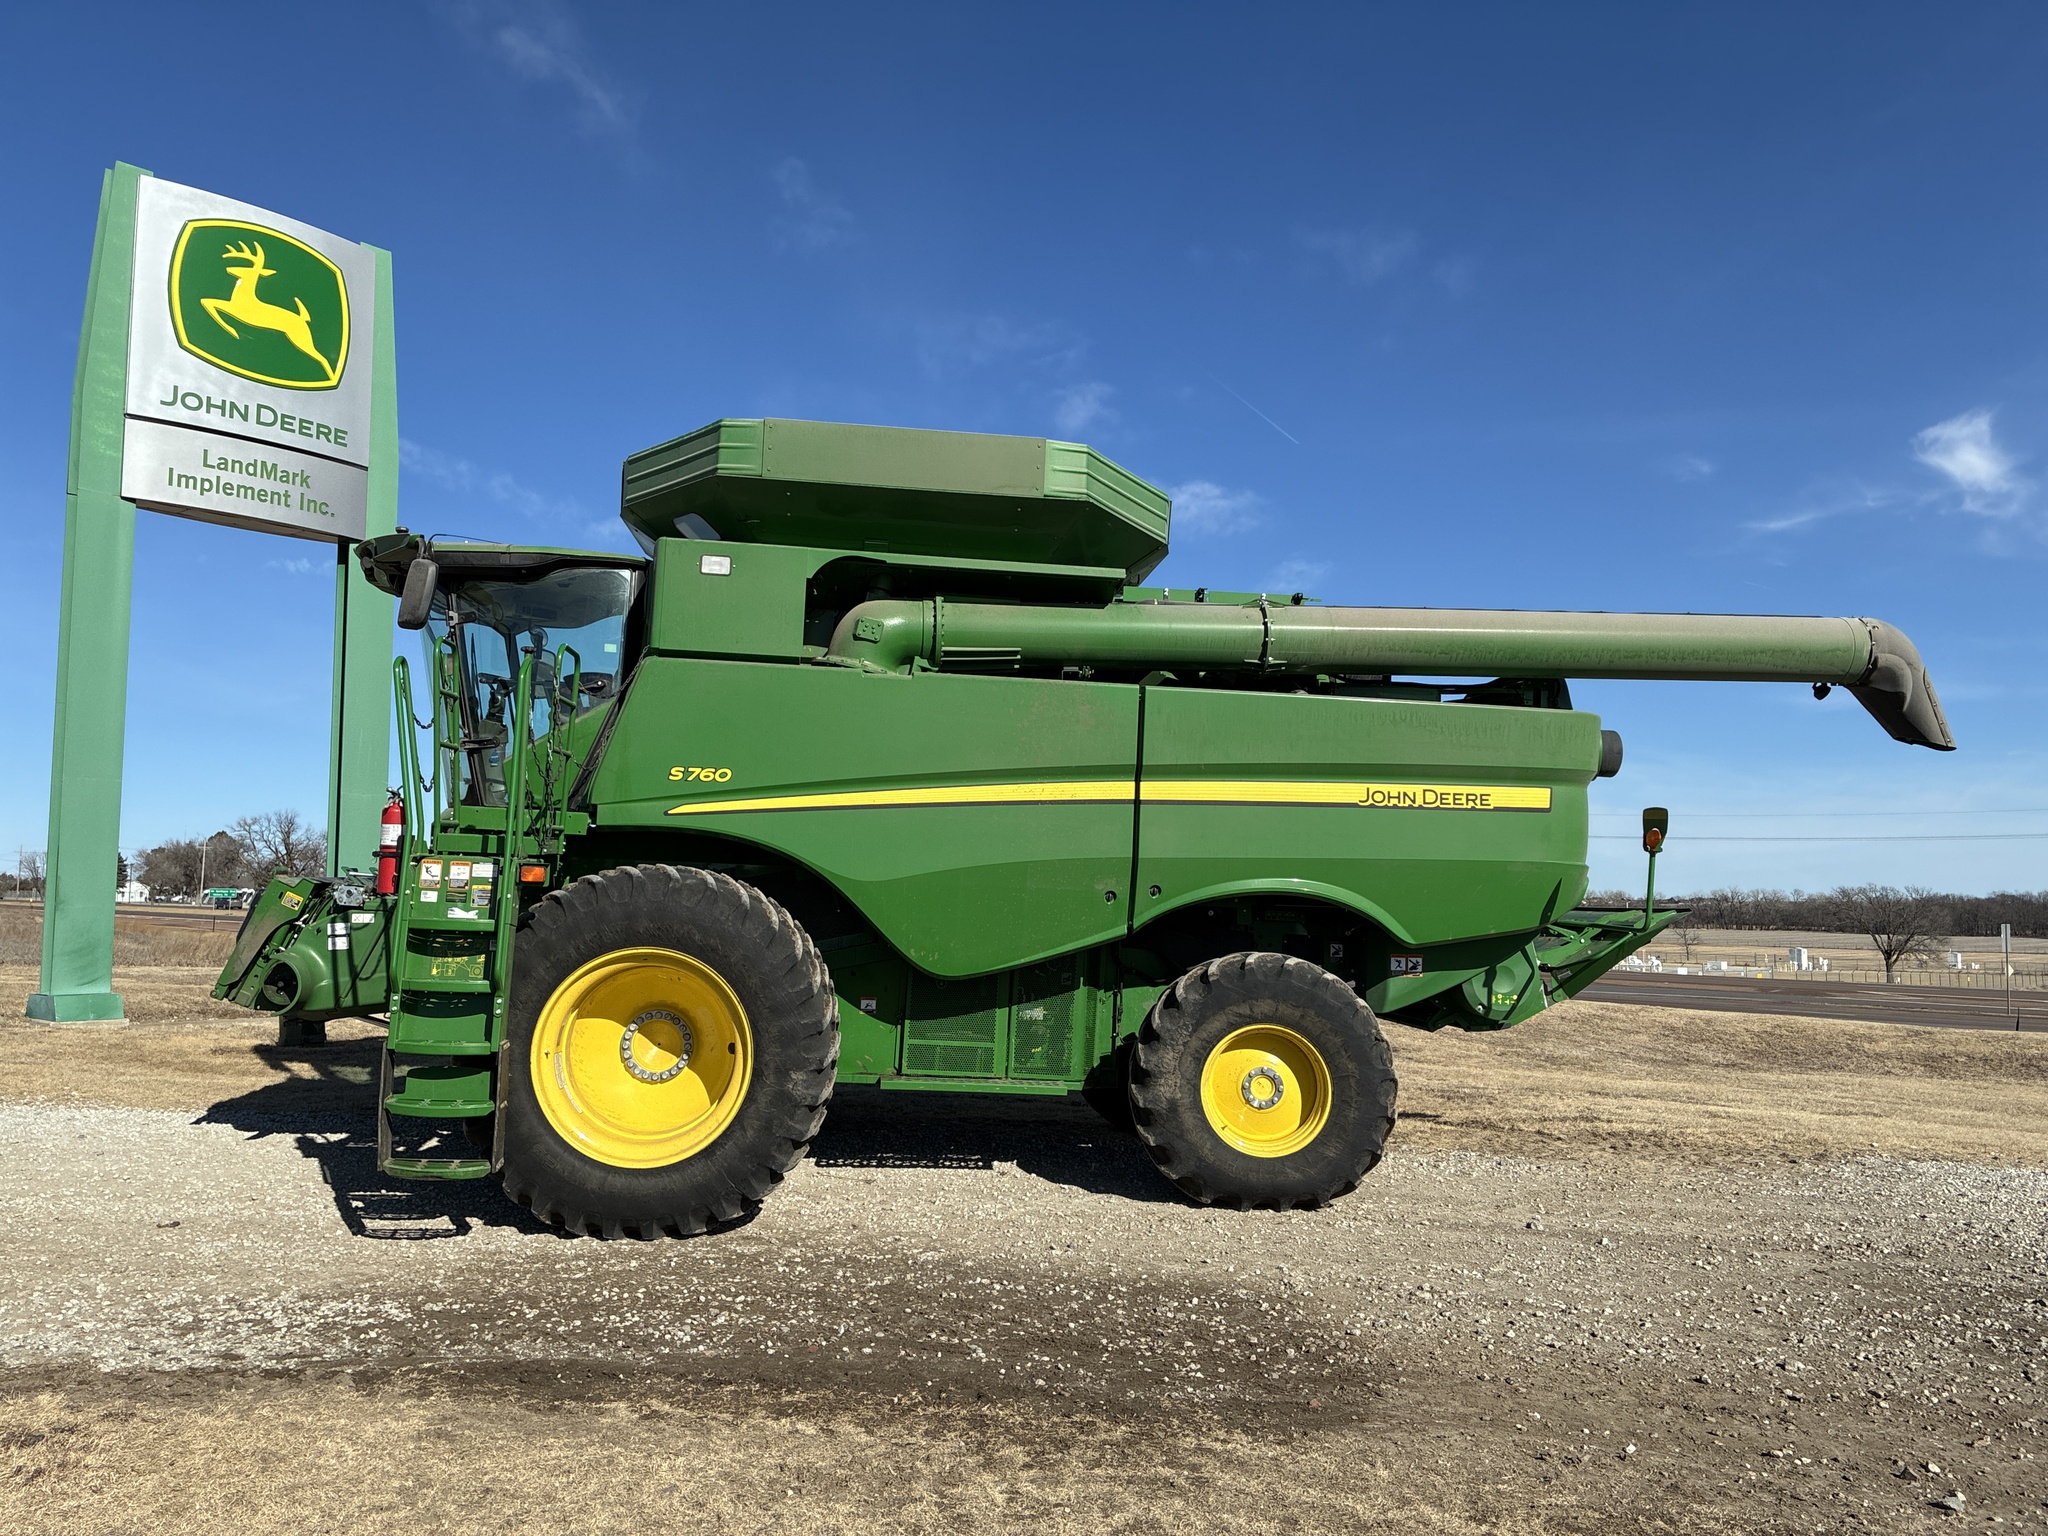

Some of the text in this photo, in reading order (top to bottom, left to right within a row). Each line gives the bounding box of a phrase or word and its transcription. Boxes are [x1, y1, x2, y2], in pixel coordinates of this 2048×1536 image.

[160, 385, 348, 448] JOHN DEERE
[203, 449, 311, 489] LandMark
[168, 467, 335, 517] Implement Inc.
[1359, 787, 1491, 806] JOHN DEERE
